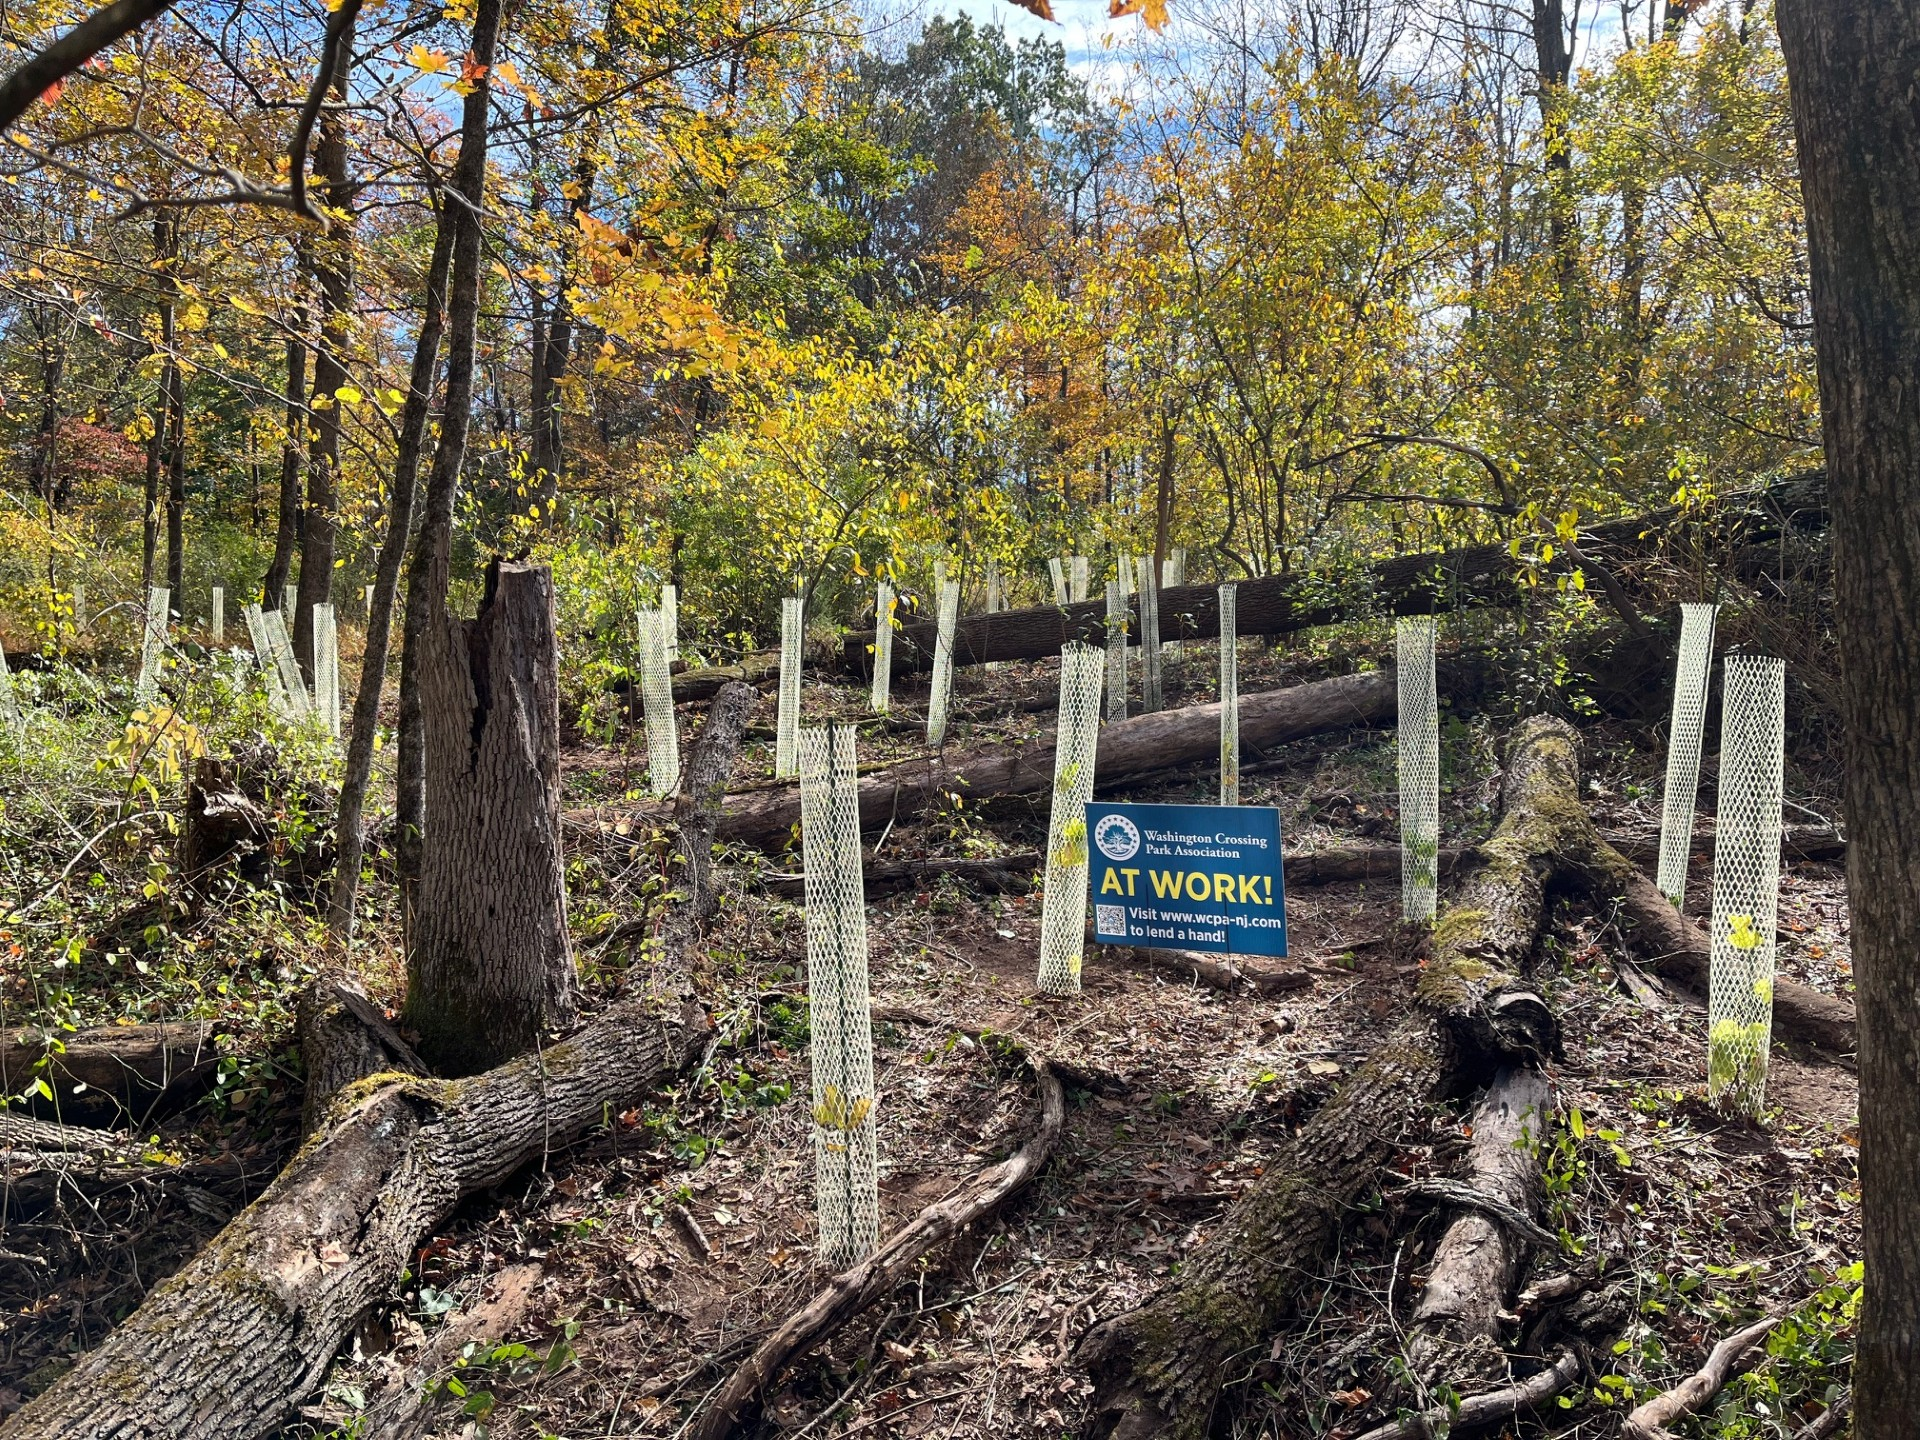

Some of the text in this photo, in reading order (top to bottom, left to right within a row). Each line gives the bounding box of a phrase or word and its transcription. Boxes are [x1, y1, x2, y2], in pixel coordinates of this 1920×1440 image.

[1144, 830, 1267, 849] Washington Crossing
[1146, 845, 1240, 859] Park Association
[1101, 867, 1273, 905] AT WORK!
[1130, 907, 1281, 928] Visit www.wcpa-nj.com
[1130, 925, 1225, 942] to lend a hand!
